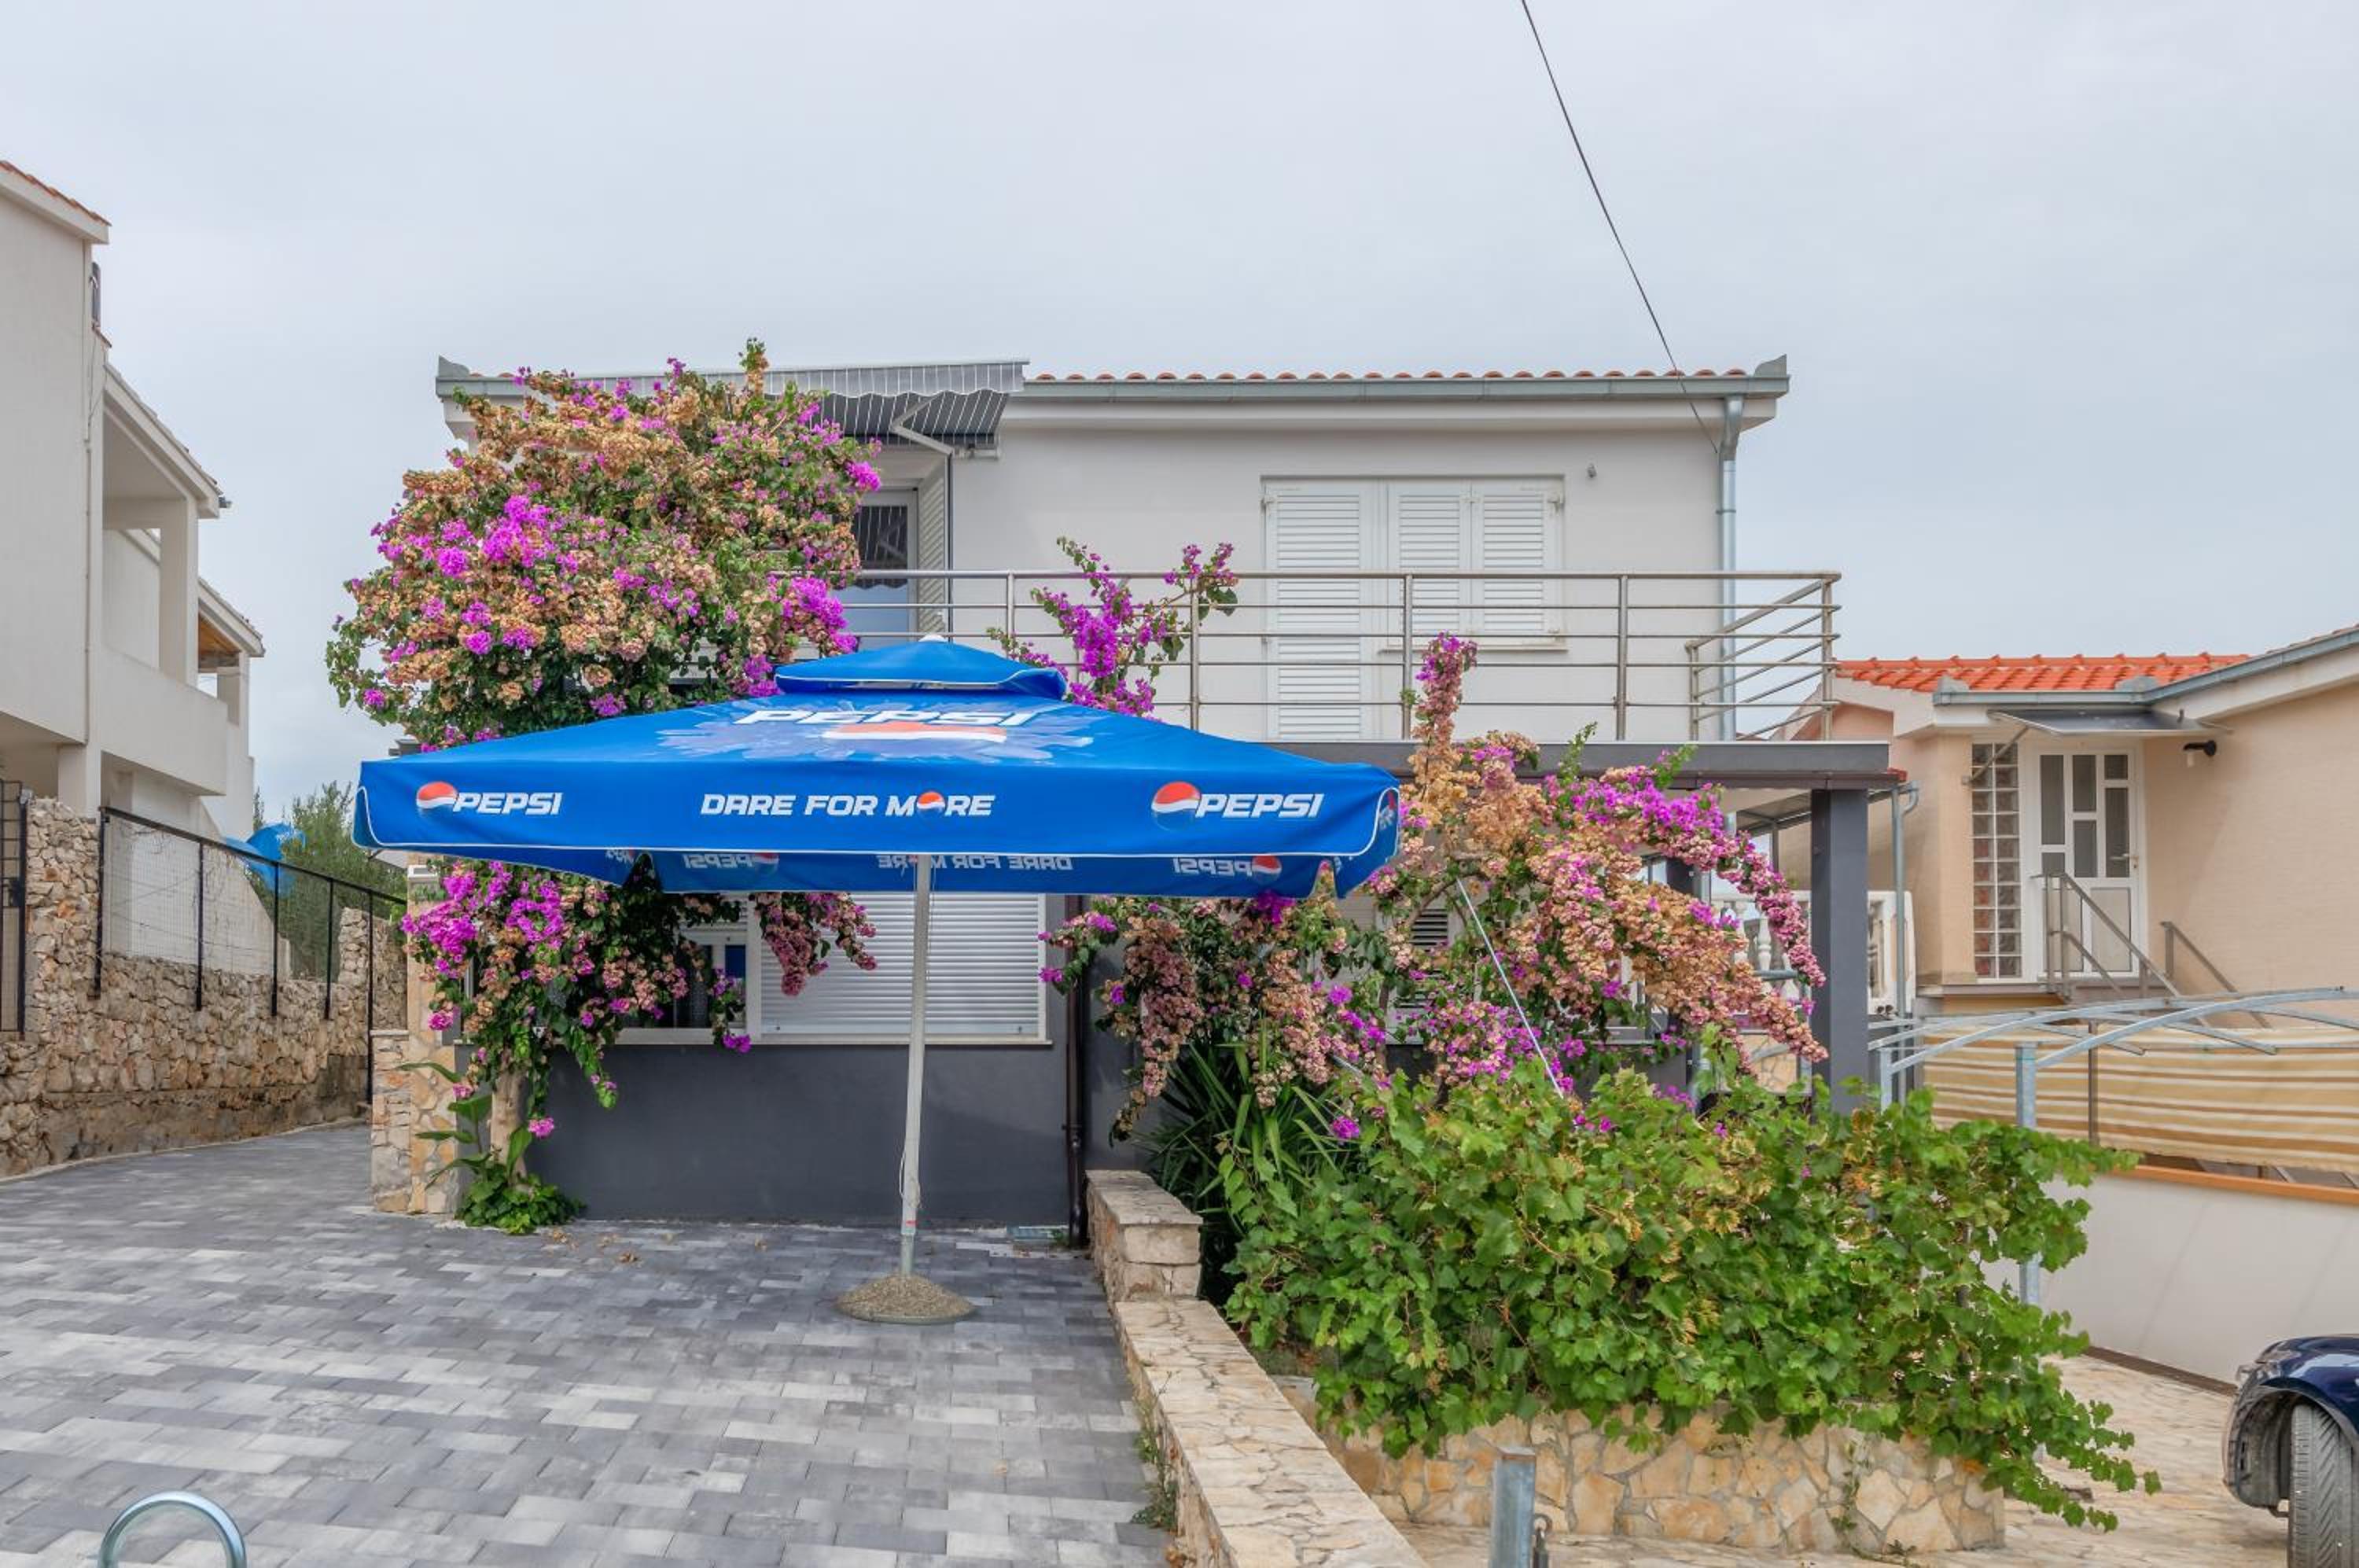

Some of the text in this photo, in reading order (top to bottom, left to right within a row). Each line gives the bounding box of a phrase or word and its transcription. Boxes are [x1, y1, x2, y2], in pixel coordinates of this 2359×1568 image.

[733, 709, 1040, 726] PEPSI
[453, 792, 564, 815] PEPSI
[701, 793, 796, 815] DARE
[803, 794, 878, 816] FOR
[1194, 793, 1324, 819] PEPSI
